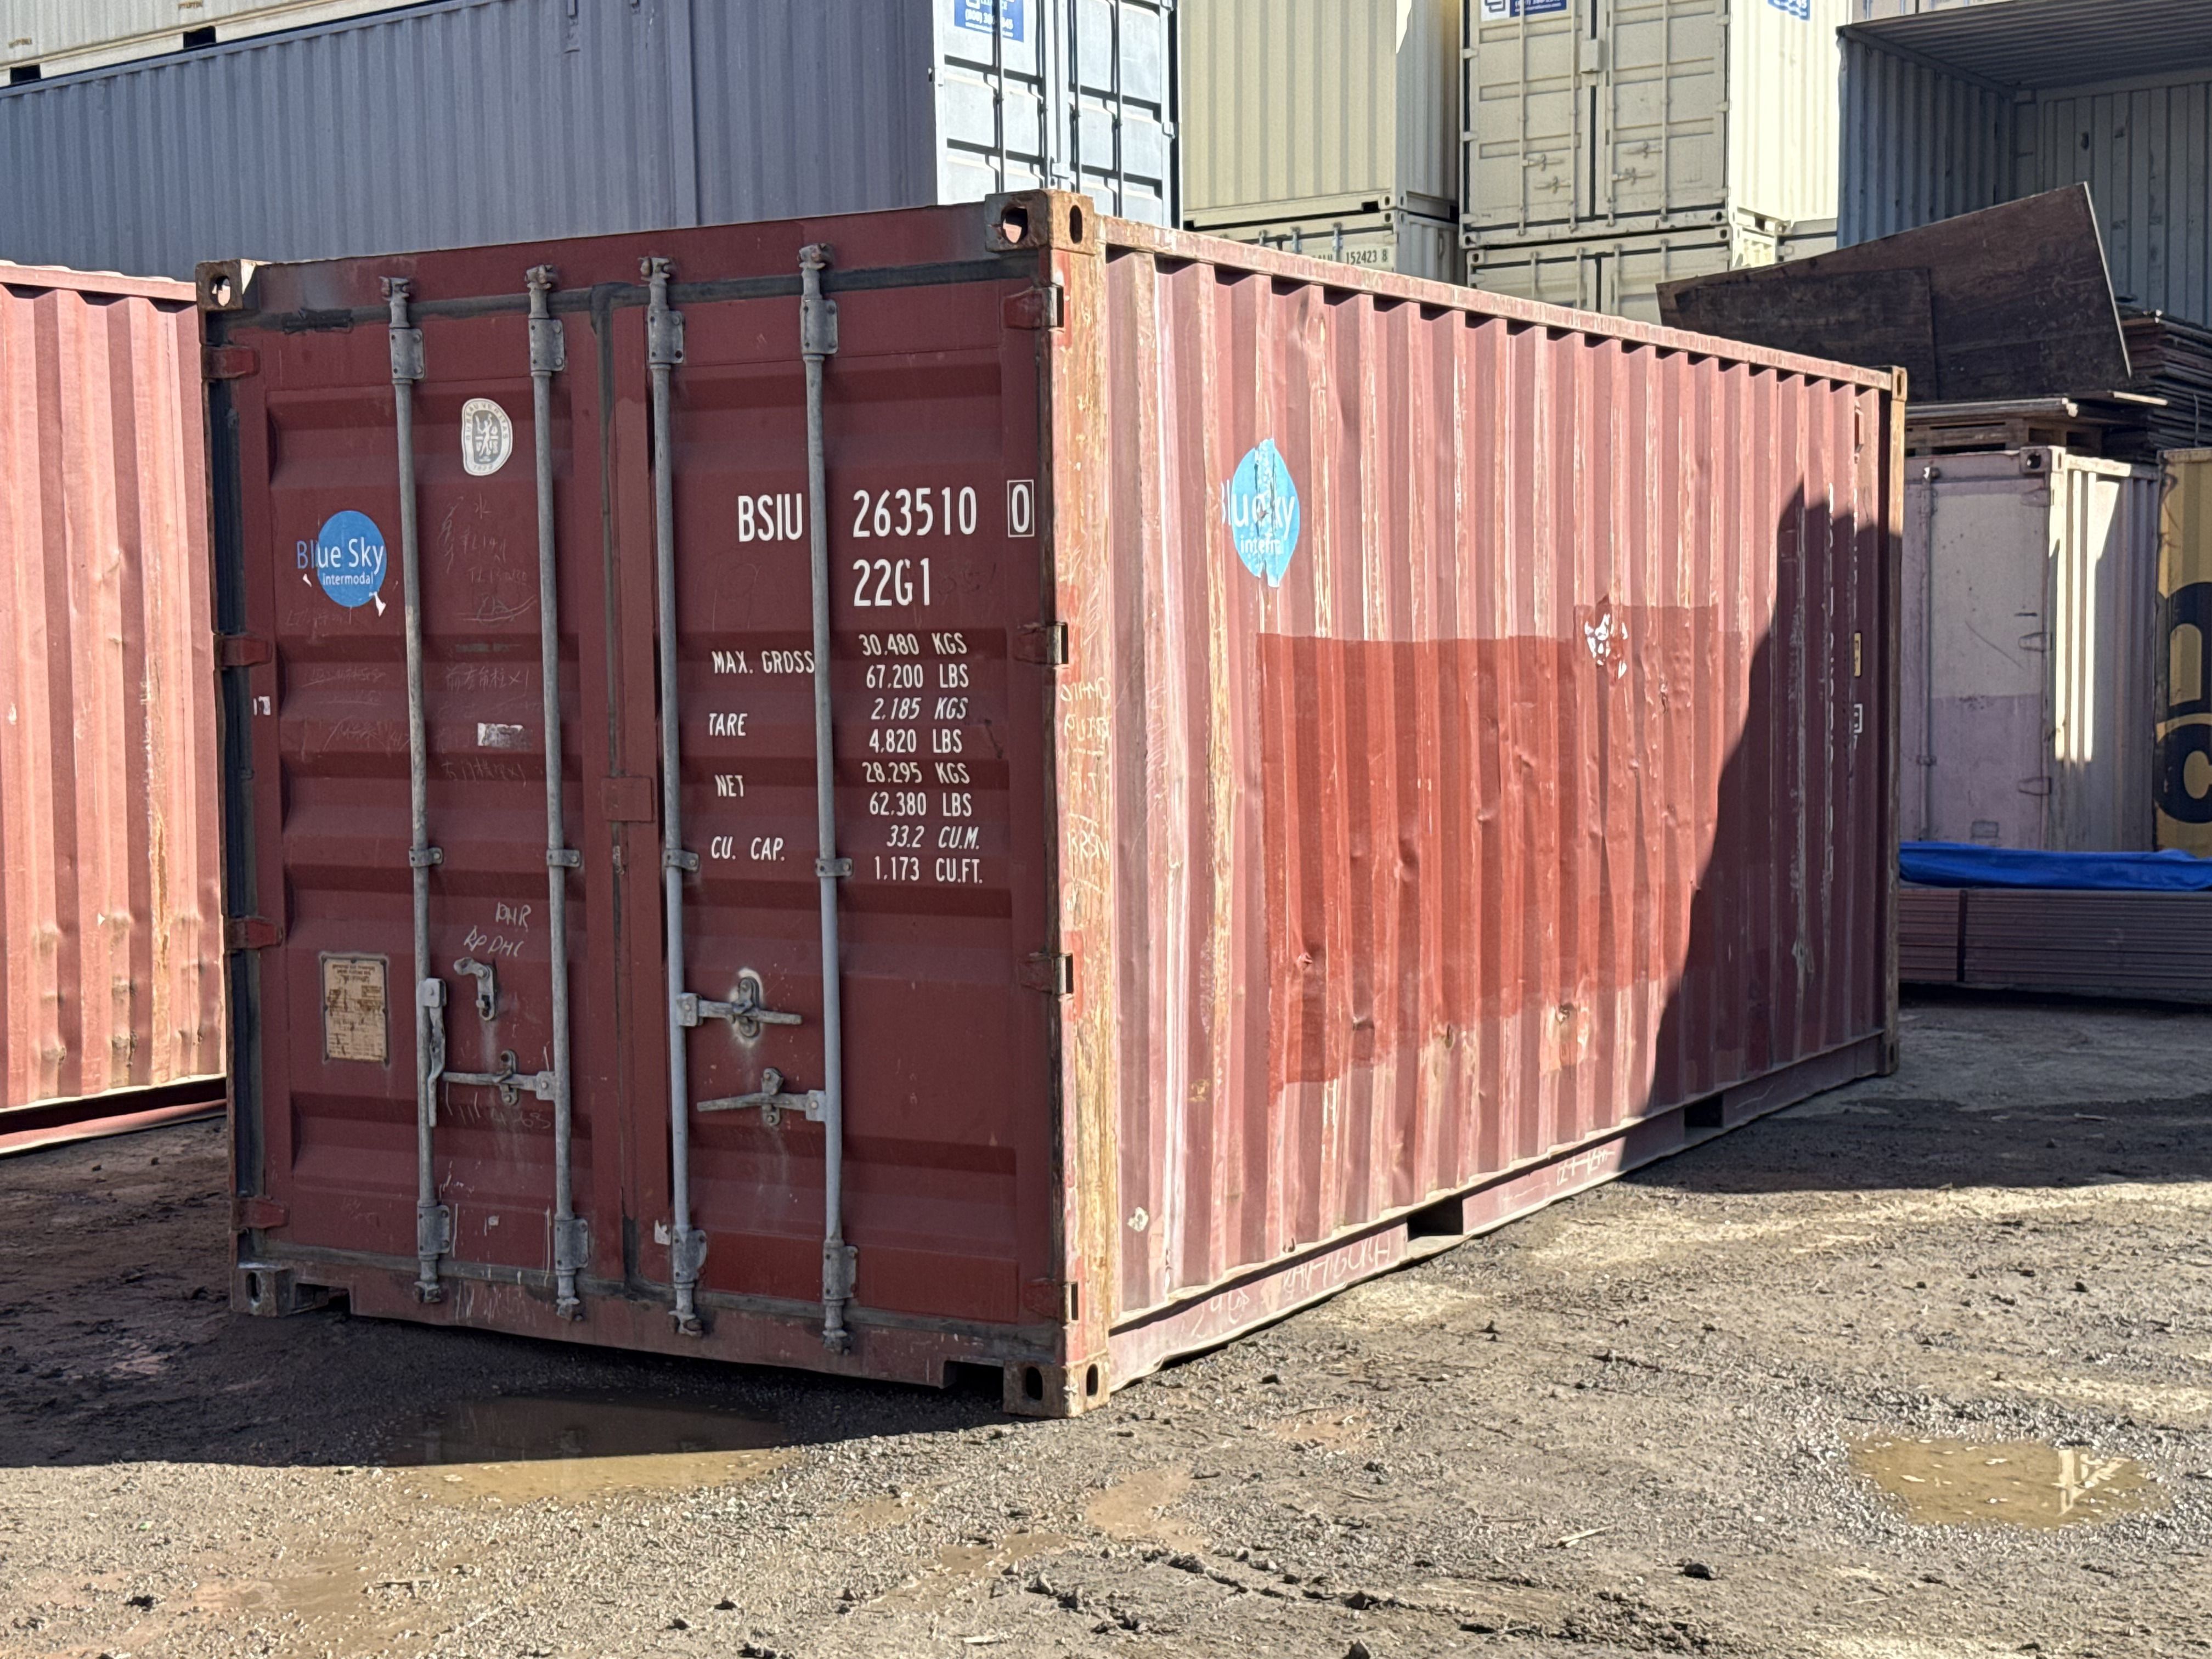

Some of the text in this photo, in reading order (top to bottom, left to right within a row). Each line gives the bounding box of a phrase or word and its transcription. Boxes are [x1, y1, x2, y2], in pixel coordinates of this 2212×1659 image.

[1346, 249, 1377, 265] 152423
[1382, 249, 1387, 263] 8
[738, 484, 1030, 542] BSIU 263510 0
[296, 537, 384, 575] Blue Sky
[323, 571, 374, 585] intermodal
[853, 558, 930, 606] 22G1
[932, 633, 967, 655] KGS
[712, 651, 815, 674] MAX. GROSS
[940, 664, 969, 688] LBS
[934, 697, 969, 720] KGS
[709, 713, 748, 736] TARE
[933, 729, 962, 753] LBS
[935, 761, 970, 784] KGS
[715, 775, 744, 797] NET
[943, 792, 972, 816] LBS
[712, 836, 785, 861] CU. CAP.
[887, 825, 980, 849] 33.2 CU.M.
[936, 857, 983, 884] CU.FT.
